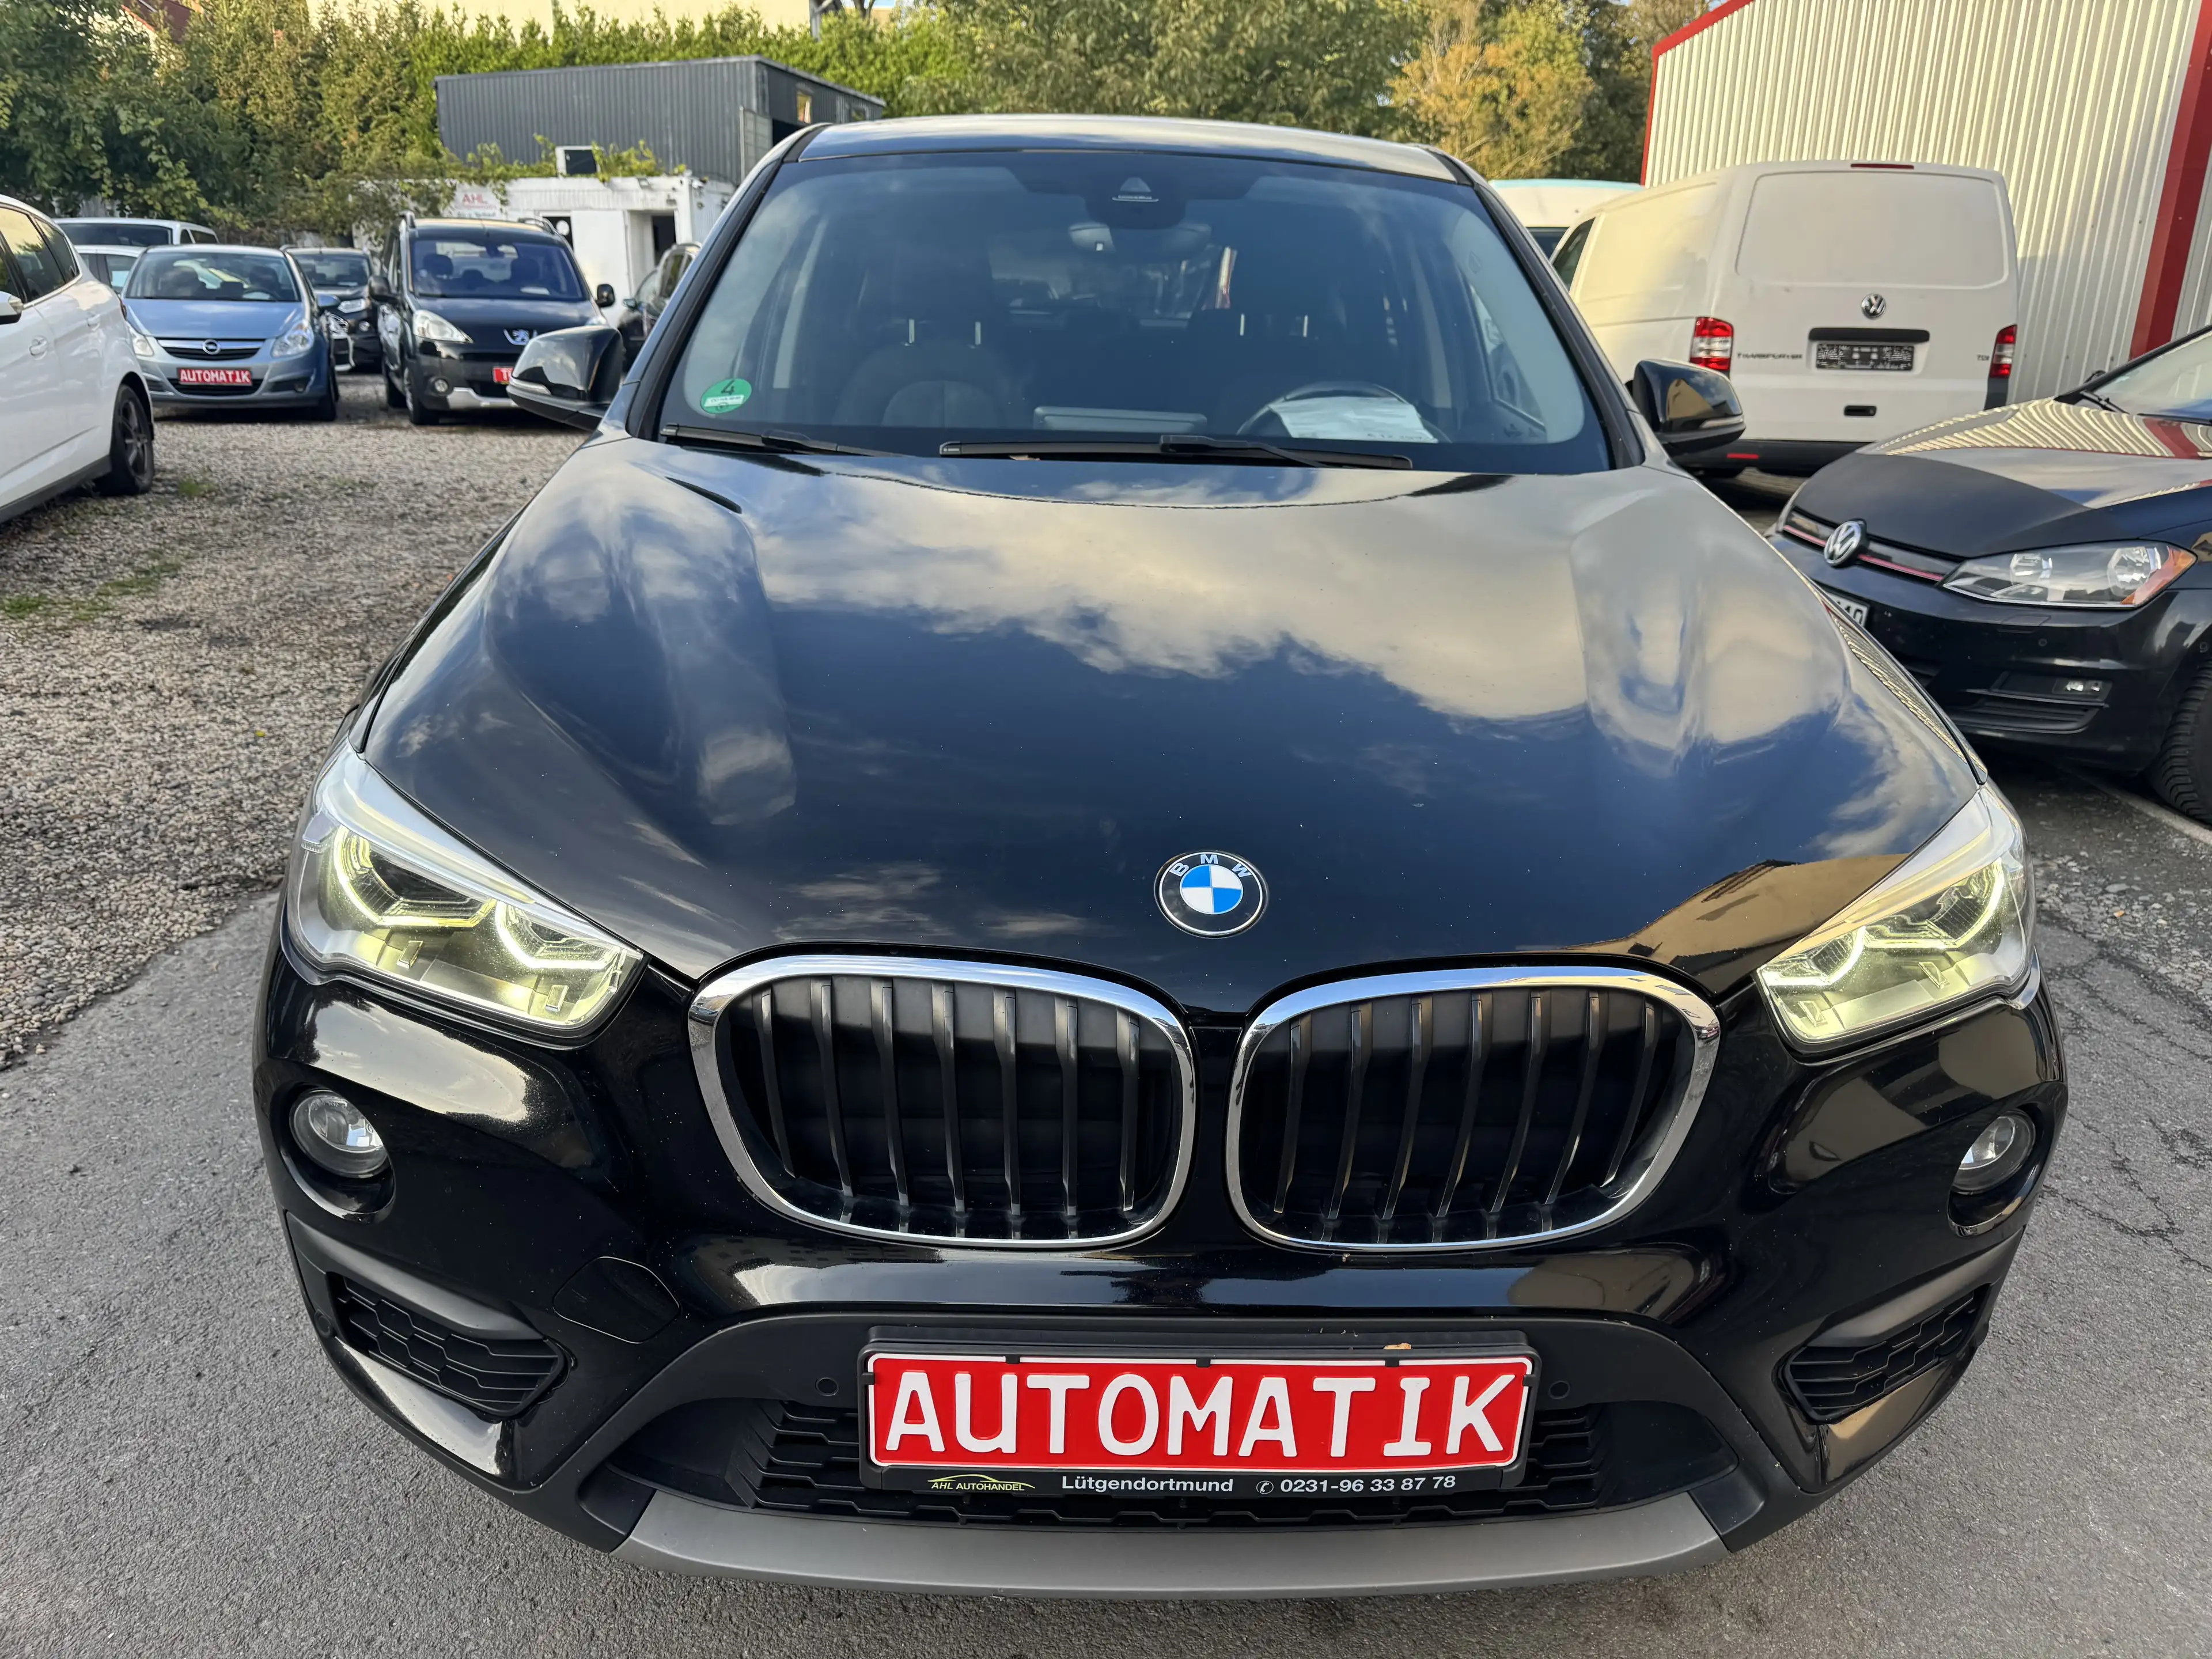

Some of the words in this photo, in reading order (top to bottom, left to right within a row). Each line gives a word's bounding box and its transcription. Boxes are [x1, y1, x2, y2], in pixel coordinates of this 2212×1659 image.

[721, 380, 736, 395] 4
[1169, 854, 1252, 877] BMW
[885, 1372, 1516, 1457] AUTOMATIK
[1062, 1476, 1233, 1492] Lütgendortmund
[1280, 1479, 1364, 1493] 0231-96
[1370, 1478, 1395, 1492] 33
[1400, 1478, 1426, 1491] 87
[1432, 1475, 1456, 1488] 78
